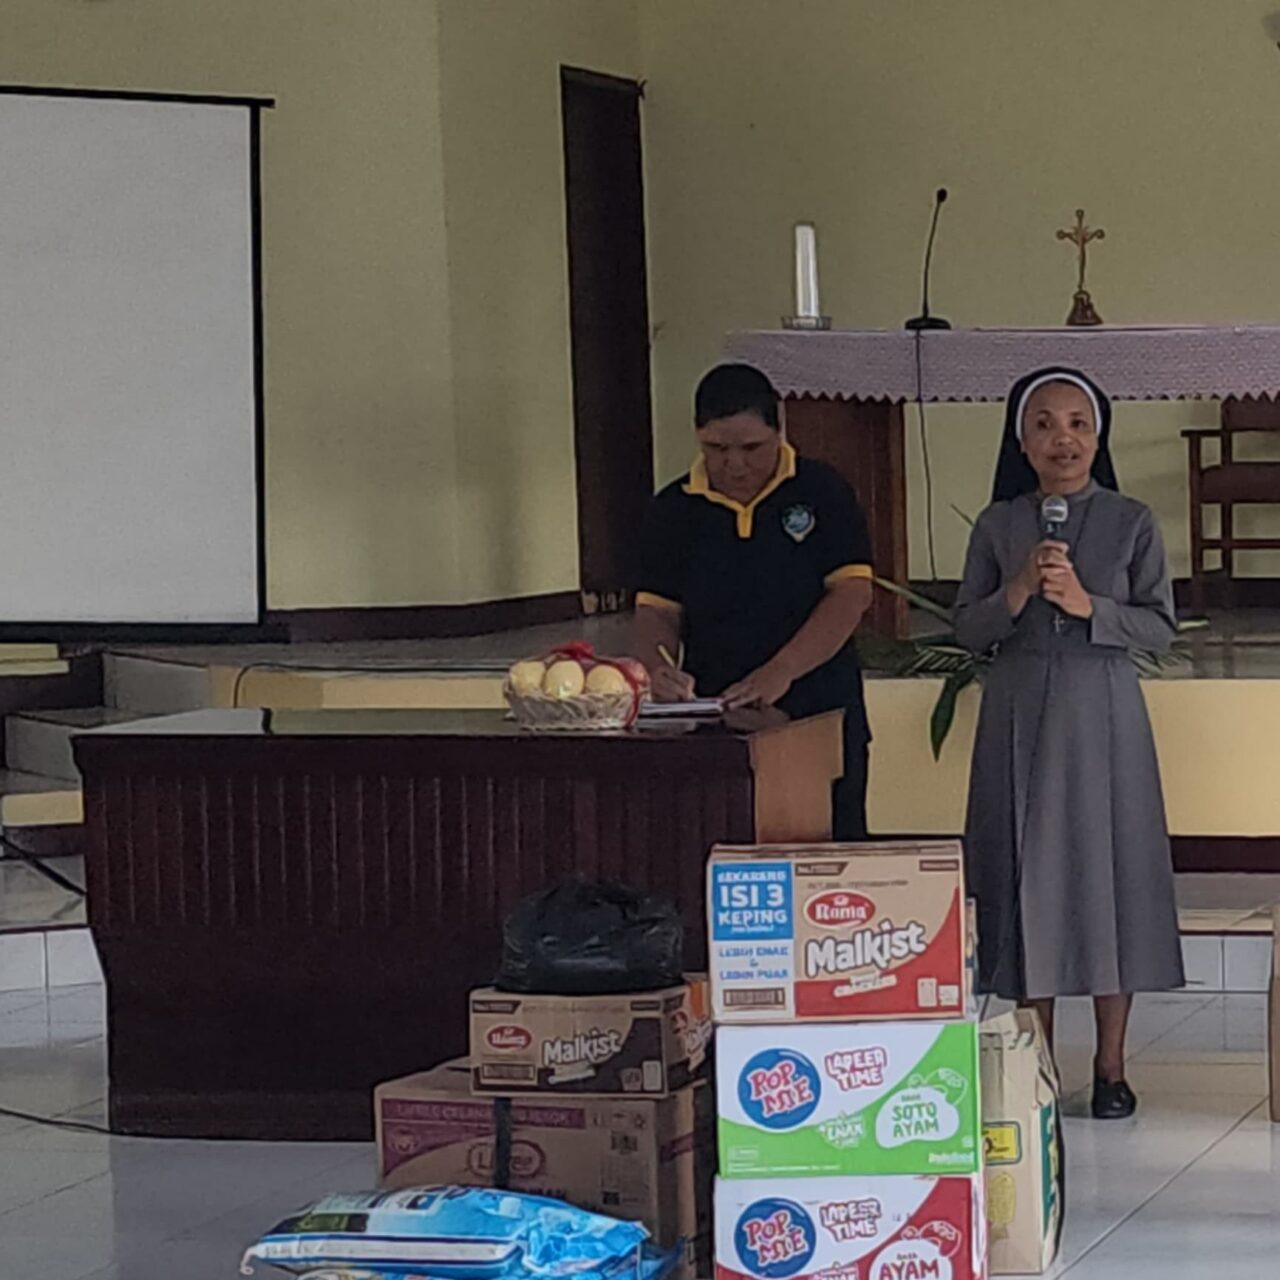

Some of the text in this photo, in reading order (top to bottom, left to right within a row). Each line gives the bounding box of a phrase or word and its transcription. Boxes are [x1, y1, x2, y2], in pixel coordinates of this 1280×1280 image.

[720, 884, 785, 907] ISI 3
[718, 910, 788, 927] KEPING
[805, 919, 927, 979] Malkist
[543, 1027, 623, 1066] Malkist
[747, 1060, 795, 1098] POP
[837, 1067, 884, 1091] TIME
[891, 1102, 937, 1122] SOTO
[892, 1119, 940, 1139] AYAM
[744, 1210, 791, 1247] POP
[831, 1219, 878, 1242] TIME
